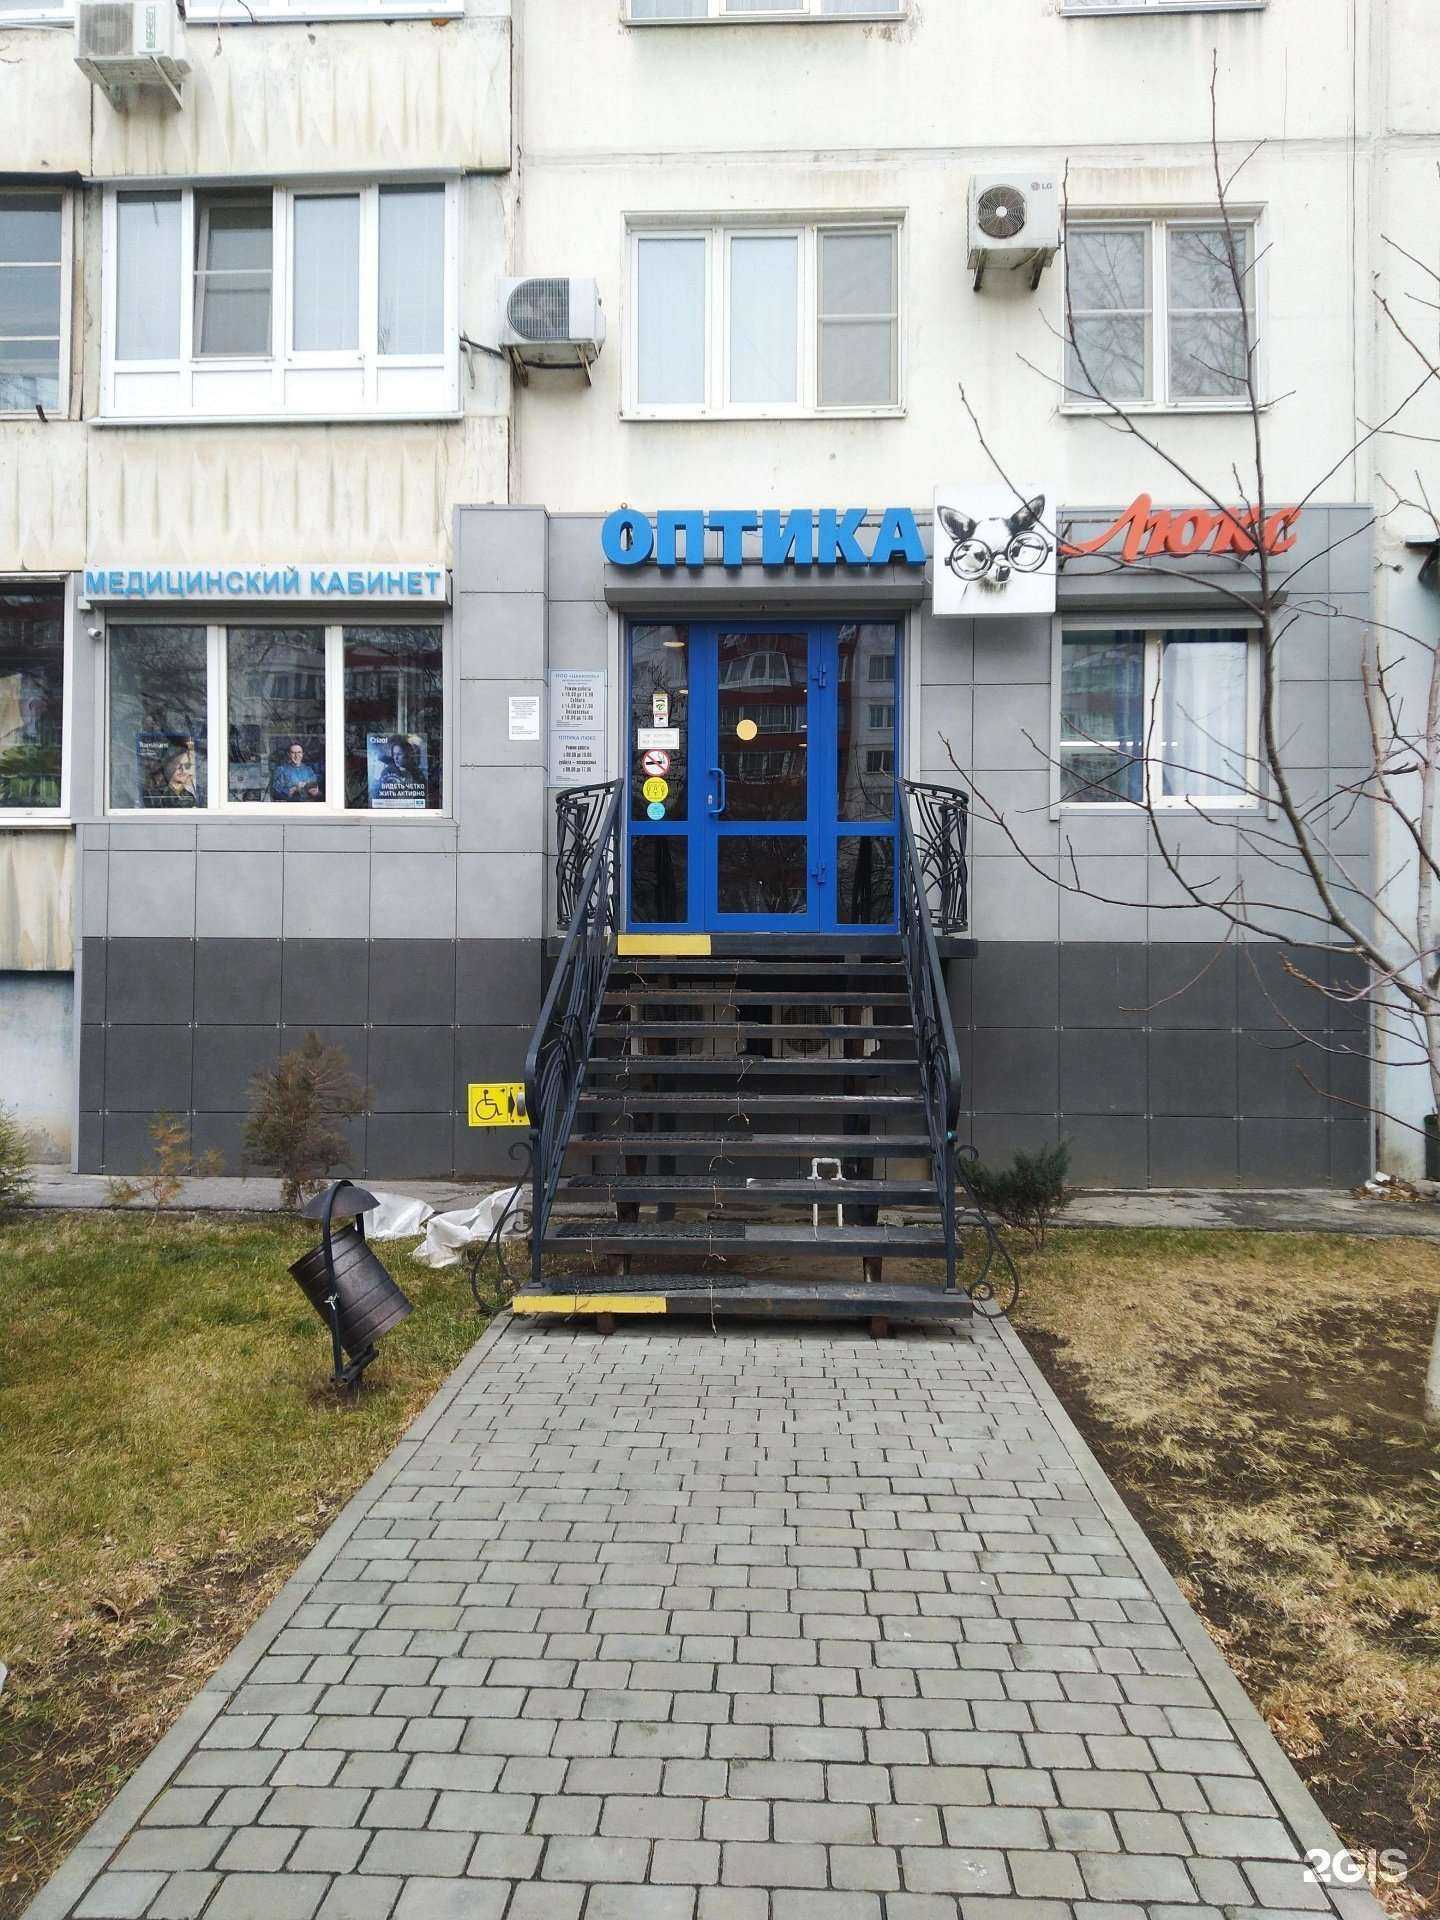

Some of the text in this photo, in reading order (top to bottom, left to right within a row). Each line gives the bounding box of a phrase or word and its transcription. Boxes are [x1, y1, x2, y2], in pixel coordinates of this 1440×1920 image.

[601, 507, 927, 567] ОПТИКА
[84, 566, 441, 598] МЕДИЦИНСКИЙ КАБИНЕТ
